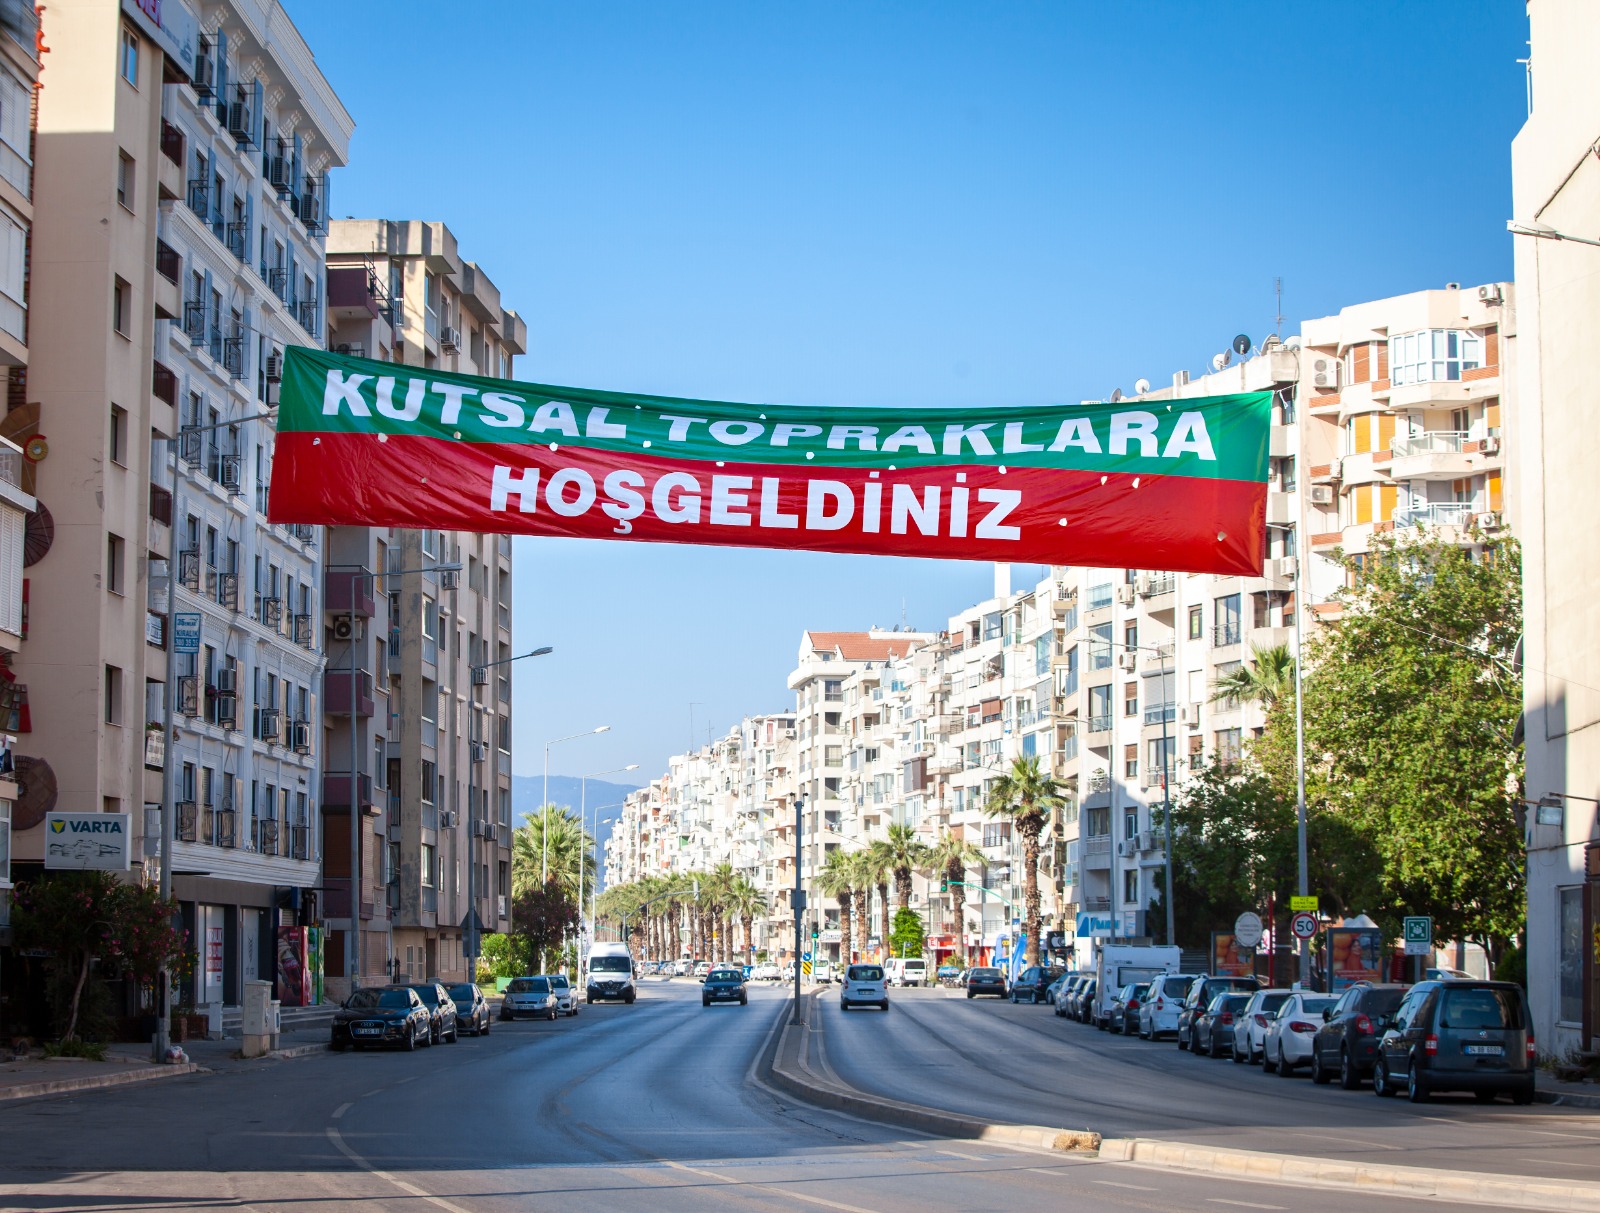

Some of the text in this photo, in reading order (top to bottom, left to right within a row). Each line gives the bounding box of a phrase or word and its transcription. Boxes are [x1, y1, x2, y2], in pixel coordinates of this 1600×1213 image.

[322, 370, 1217, 461] KUTSAL TOPRAKLARA
[490, 464, 1022, 541] HOŞGELDİNİZ
[69, 820, 122, 833] VARTA
[1296, 920, 1314, 932] 50
